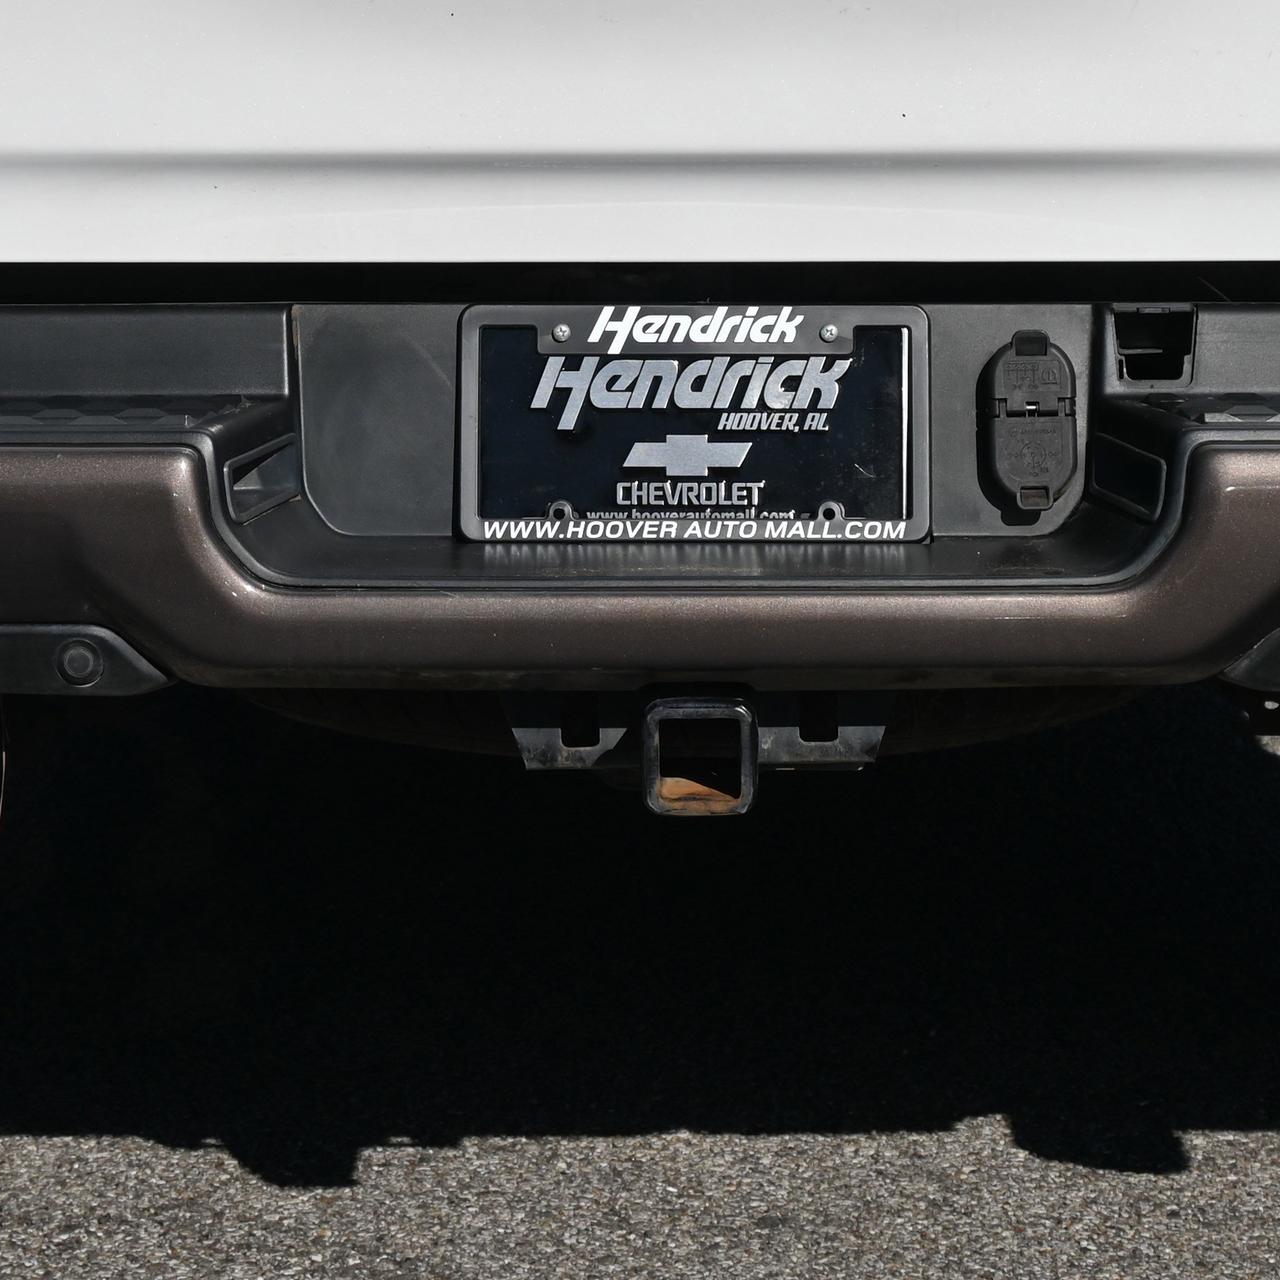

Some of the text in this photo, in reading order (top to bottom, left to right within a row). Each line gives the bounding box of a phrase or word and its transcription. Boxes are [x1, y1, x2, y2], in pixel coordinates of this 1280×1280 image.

[587, 306, 804, 354] Hendrick
[530, 356, 852, 431] Hendrick
[717, 412, 829, 433] HOOVER, AL
[616, 481, 765, 506] CHEVROLET
[586, 508, 795, 519] wwwhooverautomallcom
[483, 521, 906, 539] WWW.HOOVER AUTO MALL.COM
